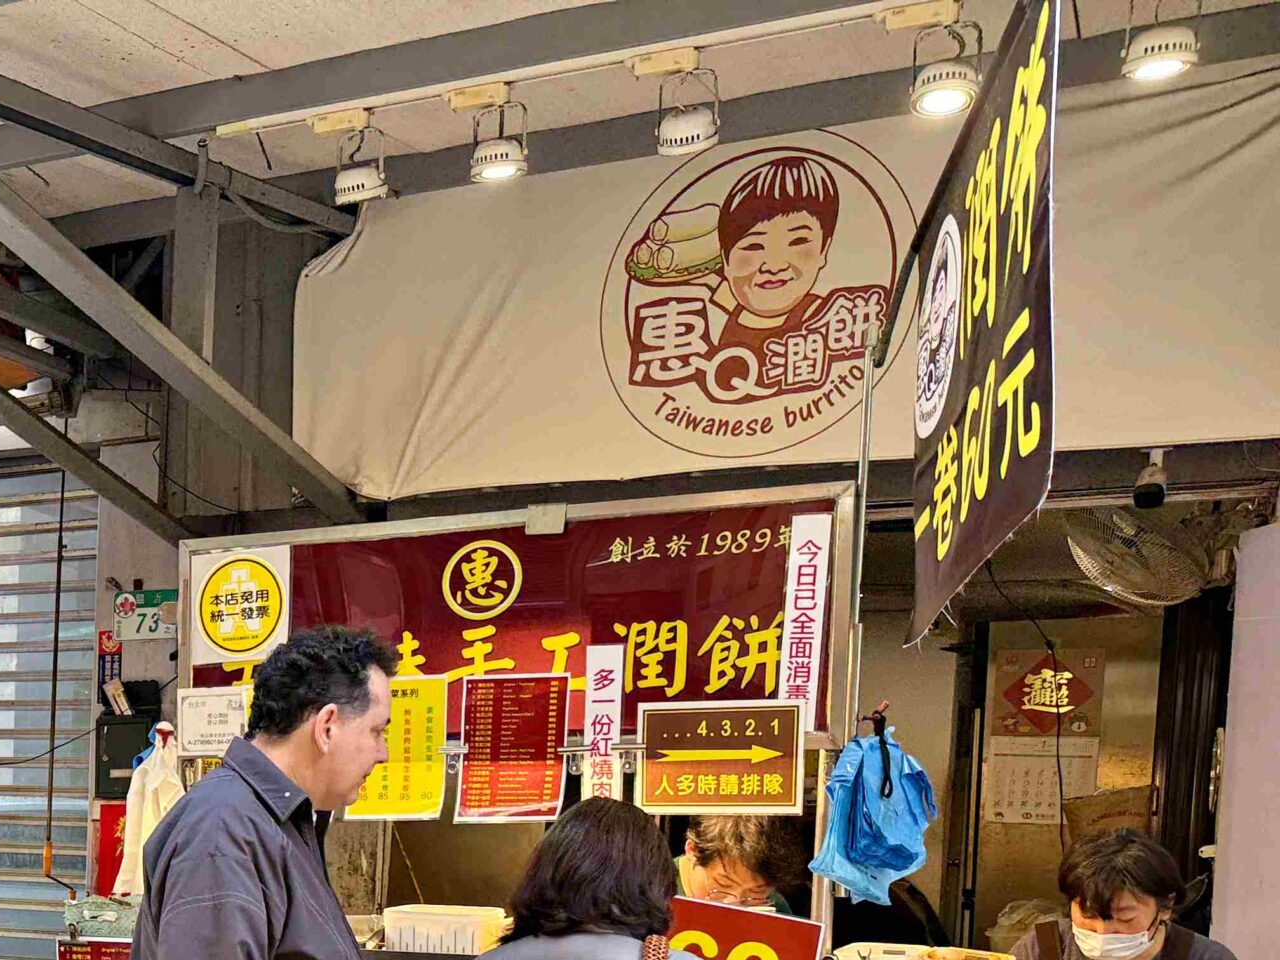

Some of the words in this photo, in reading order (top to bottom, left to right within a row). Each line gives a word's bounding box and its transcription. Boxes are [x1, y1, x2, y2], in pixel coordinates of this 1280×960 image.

[632, 292, 887, 400] 惠Q潤餅
[653, 392, 774, 437] Taiwanese
[784, 363, 865, 426] burrito
[914, 307, 1041, 562] 一卷60元
[456, 549, 508, 606] 惠
[209, 589, 269, 607] 本店免用
[209, 605, 270, 623] 統一發票
[136, 613, 159, 633] 73
[655, 773, 784, 796] 人多時請排隊
